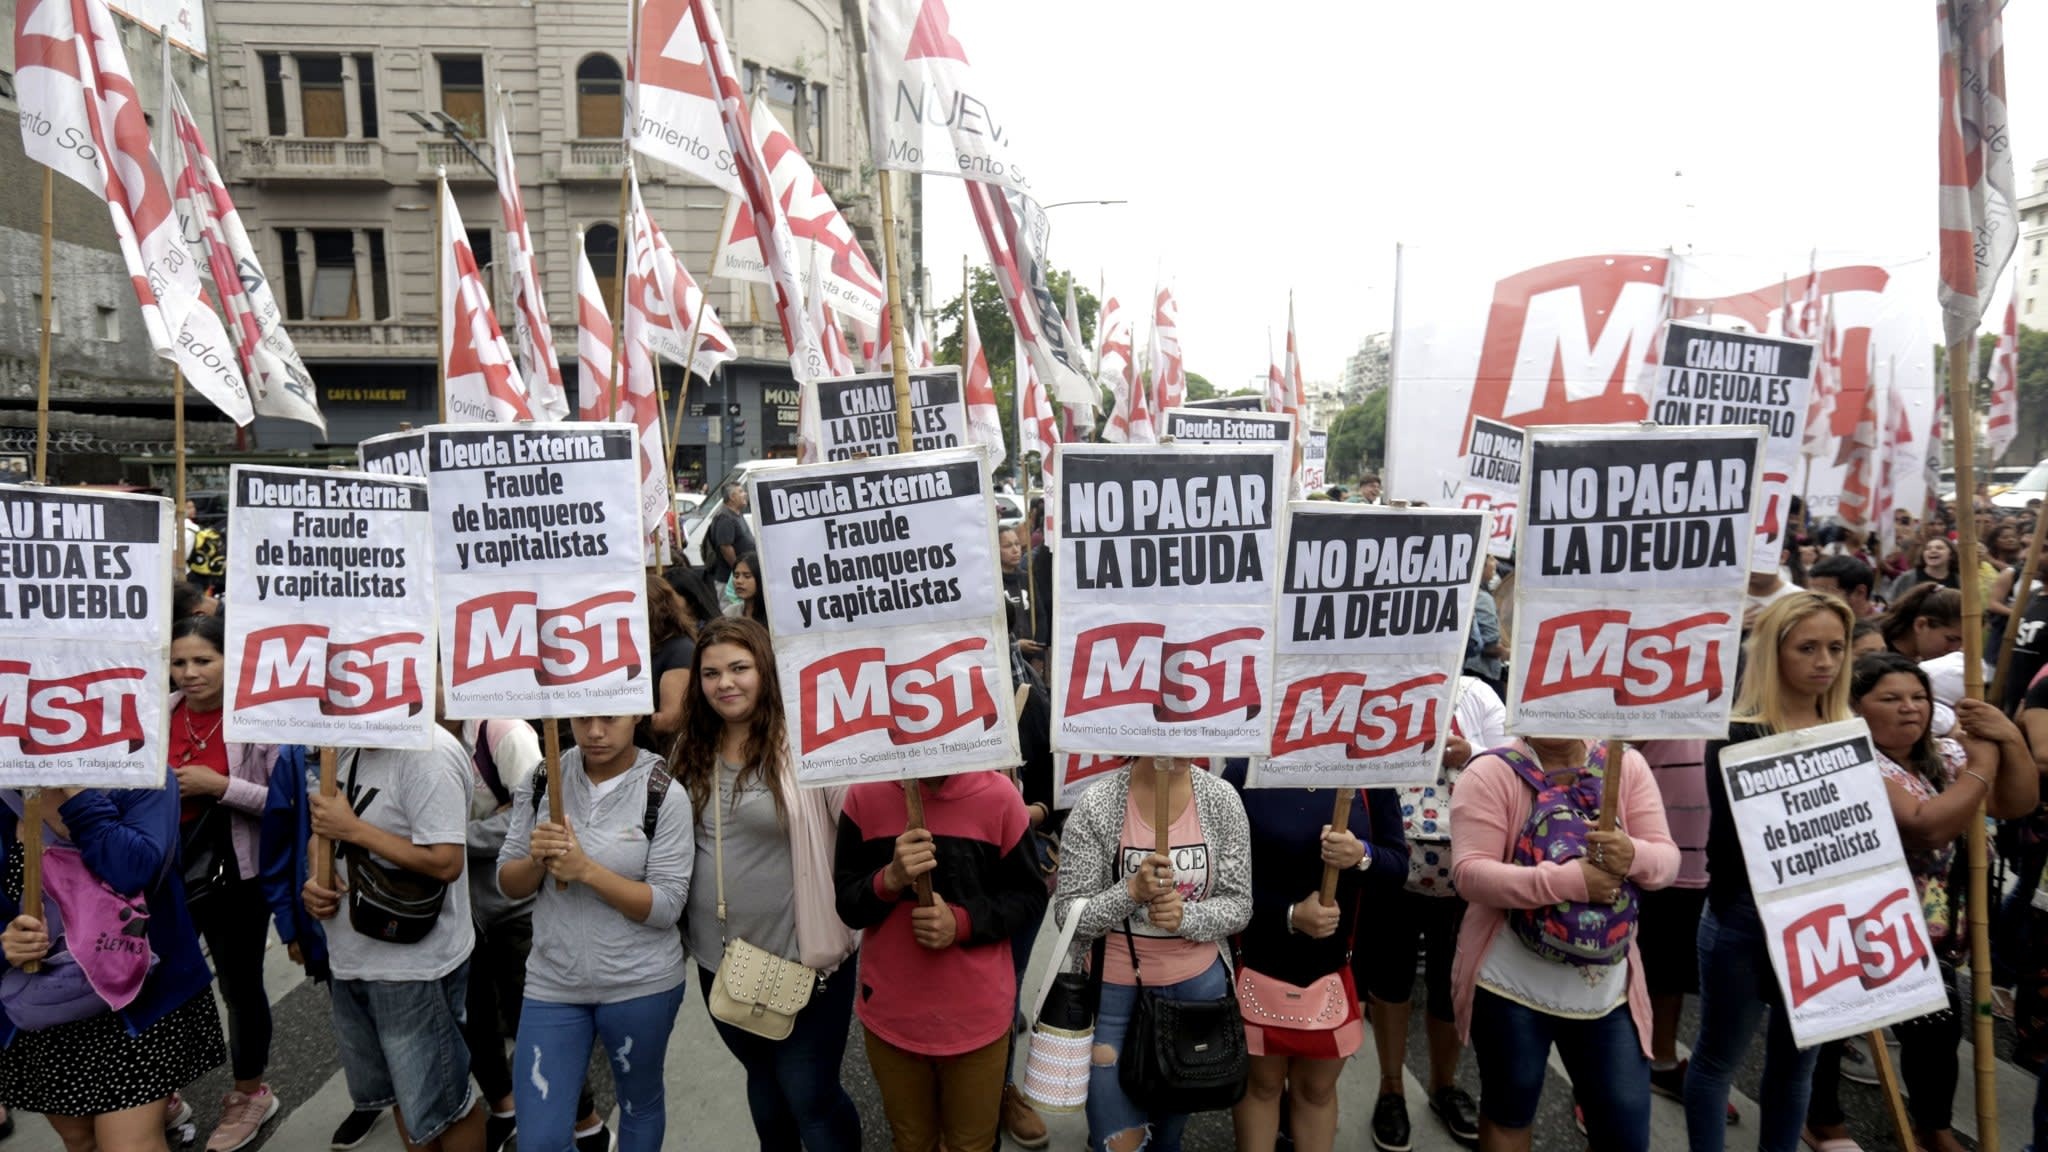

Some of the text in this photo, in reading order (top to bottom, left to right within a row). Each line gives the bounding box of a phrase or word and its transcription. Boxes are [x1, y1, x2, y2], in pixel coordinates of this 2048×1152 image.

[1685, 338, 1781, 375] CHAU FMI
[840, 384, 892, 416] CHAU
[1667, 369, 1792, 406] LA DEUDA ES
[831, 419, 856, 445] LA
[857, 410, 922, 442] DEUA
[923, 406, 947, 433] ES
[1176, 418, 1276, 440] Deuda Externa
[1473, 431, 1493, 456] NO
[440, 433, 605, 468] Deuda Externa
[1470, 456, 1485, 478] LA
[249, 478, 412, 509] Deuda Externa
[484, 466, 563, 499] Fraude
[770, 470, 953, 521] Deuda Externa
[1539, 467, 1599, 521] NO
[1607, 458, 1747, 518] PAGAR
[41, 503, 105, 540] FMI
[452, 500, 606, 533] de banqueros
[1069, 474, 1266, 533] NO PAGAR
[293, 511, 368, 539] Fraude
[824, 511, 910, 550] Fraude
[95, 545, 132, 580] ES
[256, 539, 406, 571] de banqueros
[456, 531, 609, 570] y capitalistas
[1075, 533, 1264, 589] LA DEUDA
[1293, 533, 1473, 590] NO PAGAR
[1541, 517, 1737, 576] LA DEUDA
[791, 542, 957, 589] de banqueros
[19, 584, 148, 620] PUEBLO
[257, 571, 407, 602] y capitalistas
[797, 577, 962, 628] y capitalistas
[1293, 588, 1459, 642] LA DEUDA
[467, 600, 632, 678] MST
[251, 634, 423, 710] MST
[1081, 636, 1262, 714] MST
[1540, 621, 1726, 698] MST
[451, 684, 644, 704] Movimiento Socialista de los Trabajadores
[815, 650, 985, 736] MST
[233, 715, 423, 733] Movimiento Socialista de los Trabajadores
[1062, 723, 1261, 739] Movimiento Socialista de los Trabajadores
[1284, 683, 1443, 751] MST
[38, 757, 53, 769] de
[57, 758, 73, 769] los
[78, 757, 145, 770] Trabajadores
[802, 736, 1002, 771] Movimiento Socialista de los Trabajadores
[1737, 744, 1859, 797] Deuda Externa
[1781, 779, 1840, 816] Fraude
[1763, 801, 1873, 852] de banqueros
[1126, 848, 1205, 874] GCE
[1770, 828, 1881, 884] y capitalistas
[1793, 898, 1918, 993] MST
